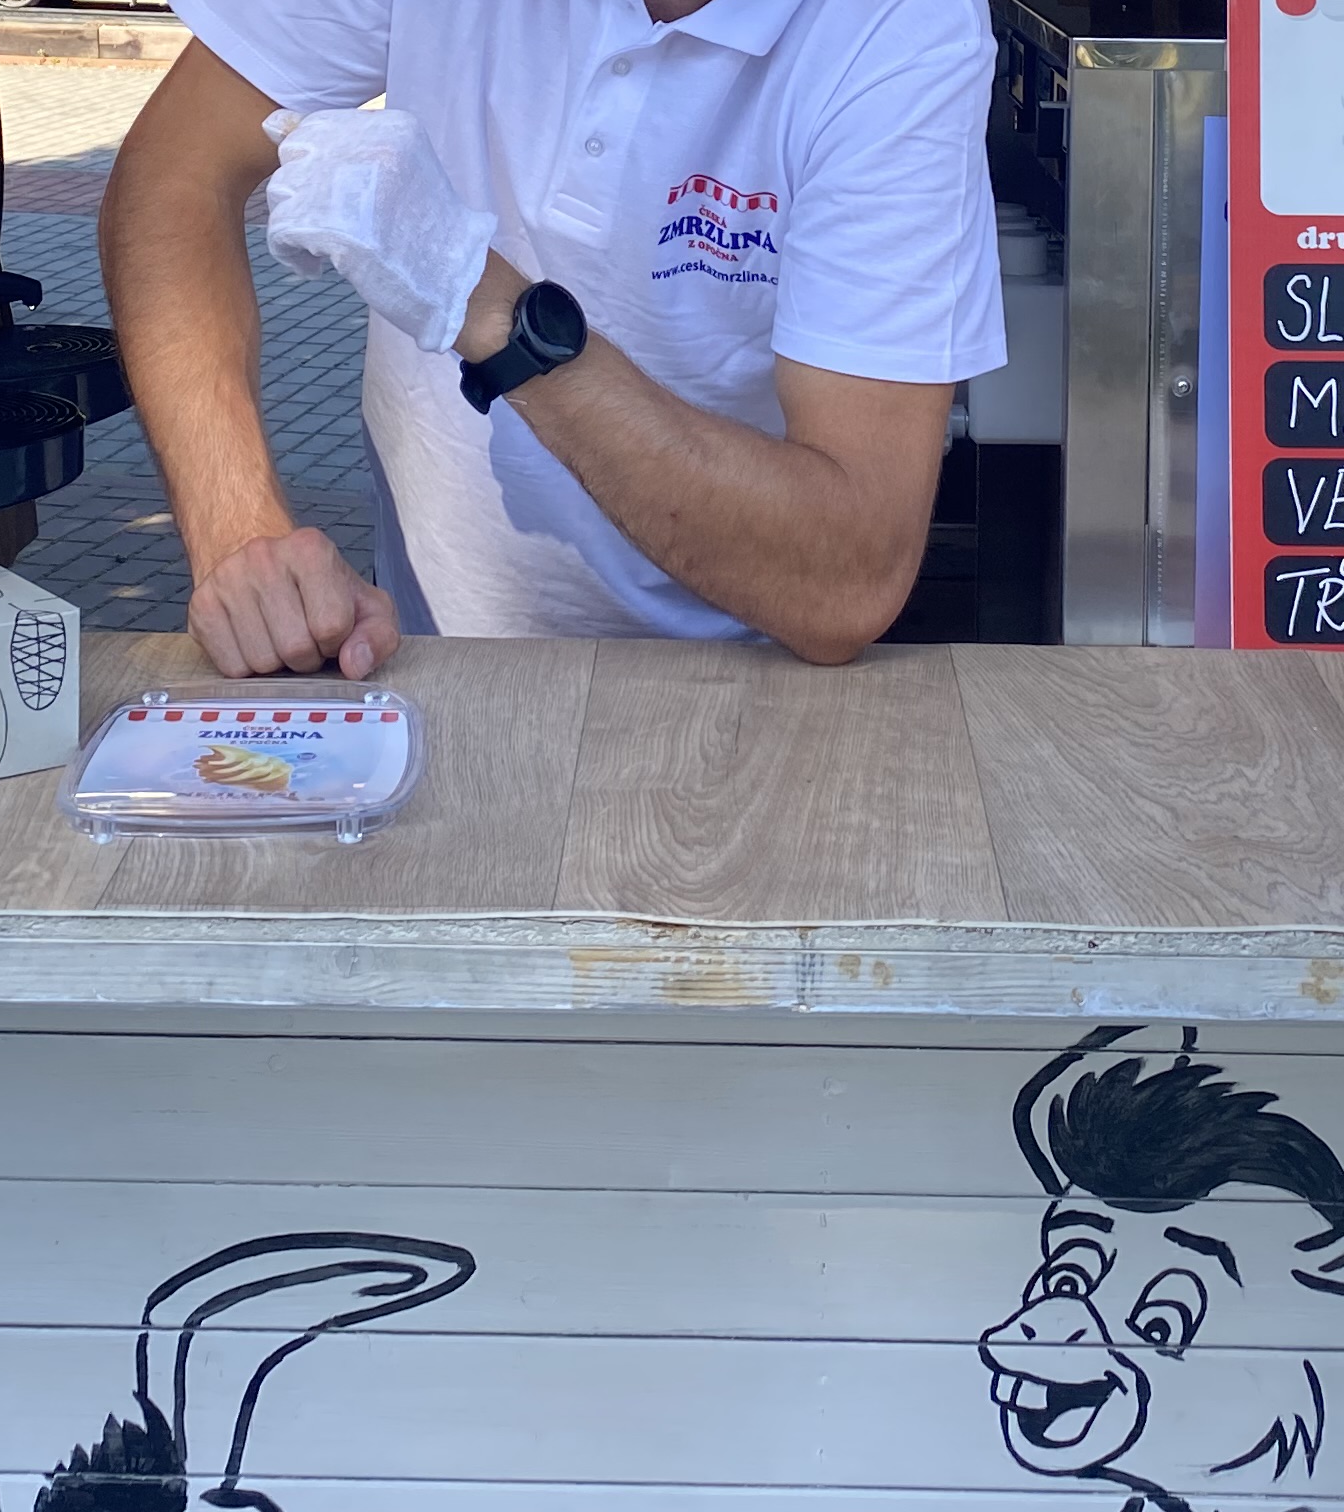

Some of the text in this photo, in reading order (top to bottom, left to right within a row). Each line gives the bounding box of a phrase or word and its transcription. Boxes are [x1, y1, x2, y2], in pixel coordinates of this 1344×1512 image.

[699, 204, 727, 228] ČESKÁ
[658, 216, 778, 254] ZMRZLINA
[687, 240, 739, 262] Z OPOČNA
[198, 731, 324, 739] ZMRZLINA
